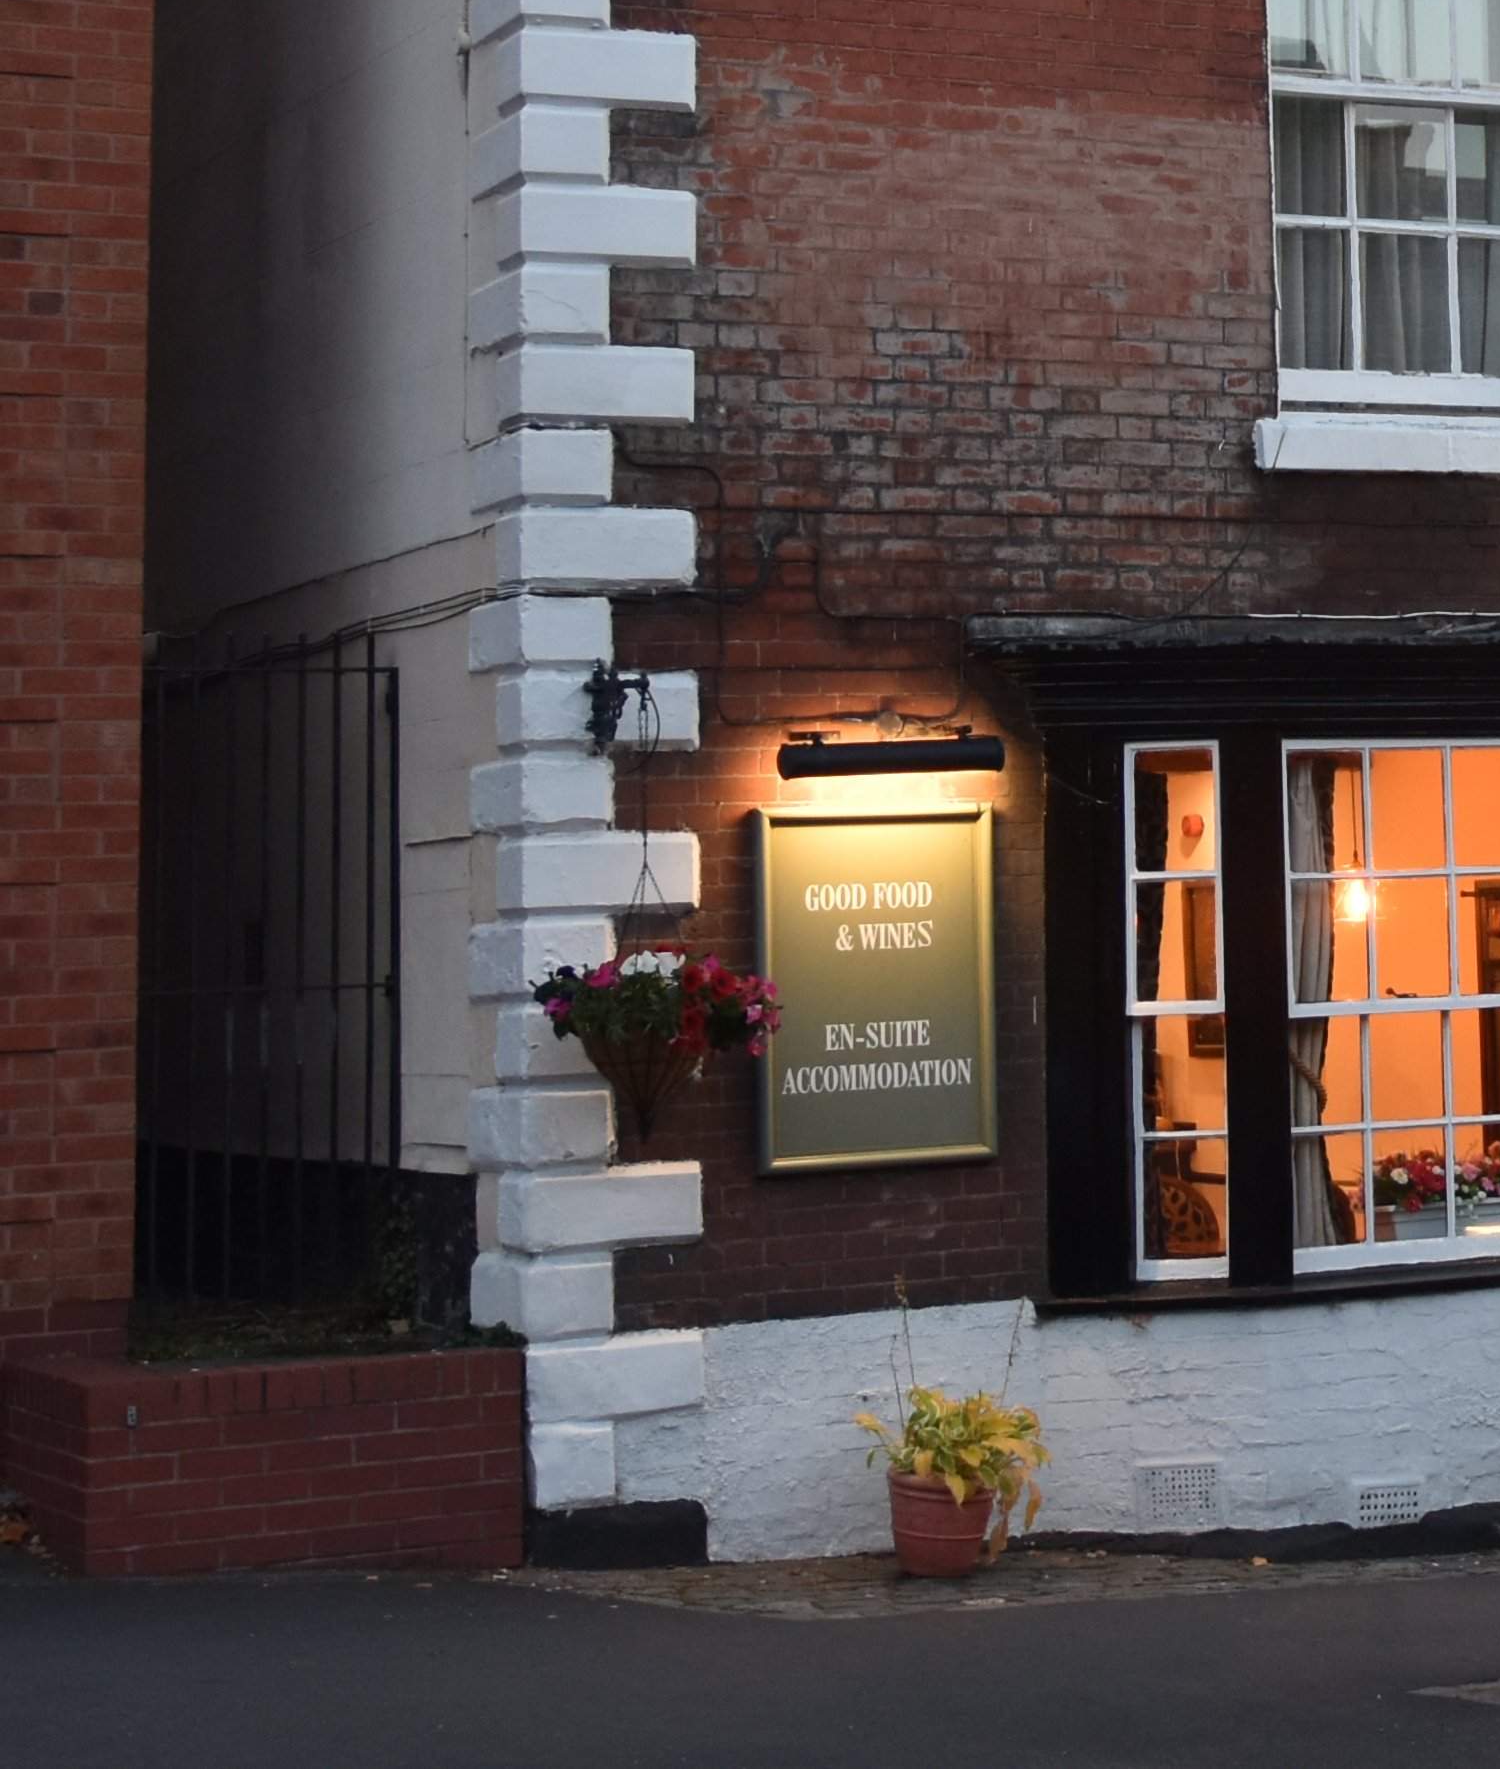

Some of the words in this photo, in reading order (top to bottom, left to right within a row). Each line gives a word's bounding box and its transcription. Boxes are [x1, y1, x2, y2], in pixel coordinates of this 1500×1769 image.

[804, 883, 867, 912] GOOD
[872, 881, 933, 910] FOOD
[835, 924, 855, 951] &
[858, 920, 933, 950] WINES
[825, 1020, 931, 1052] EN-SUITE
[781, 1058, 973, 1095] ACCOMMODATION
